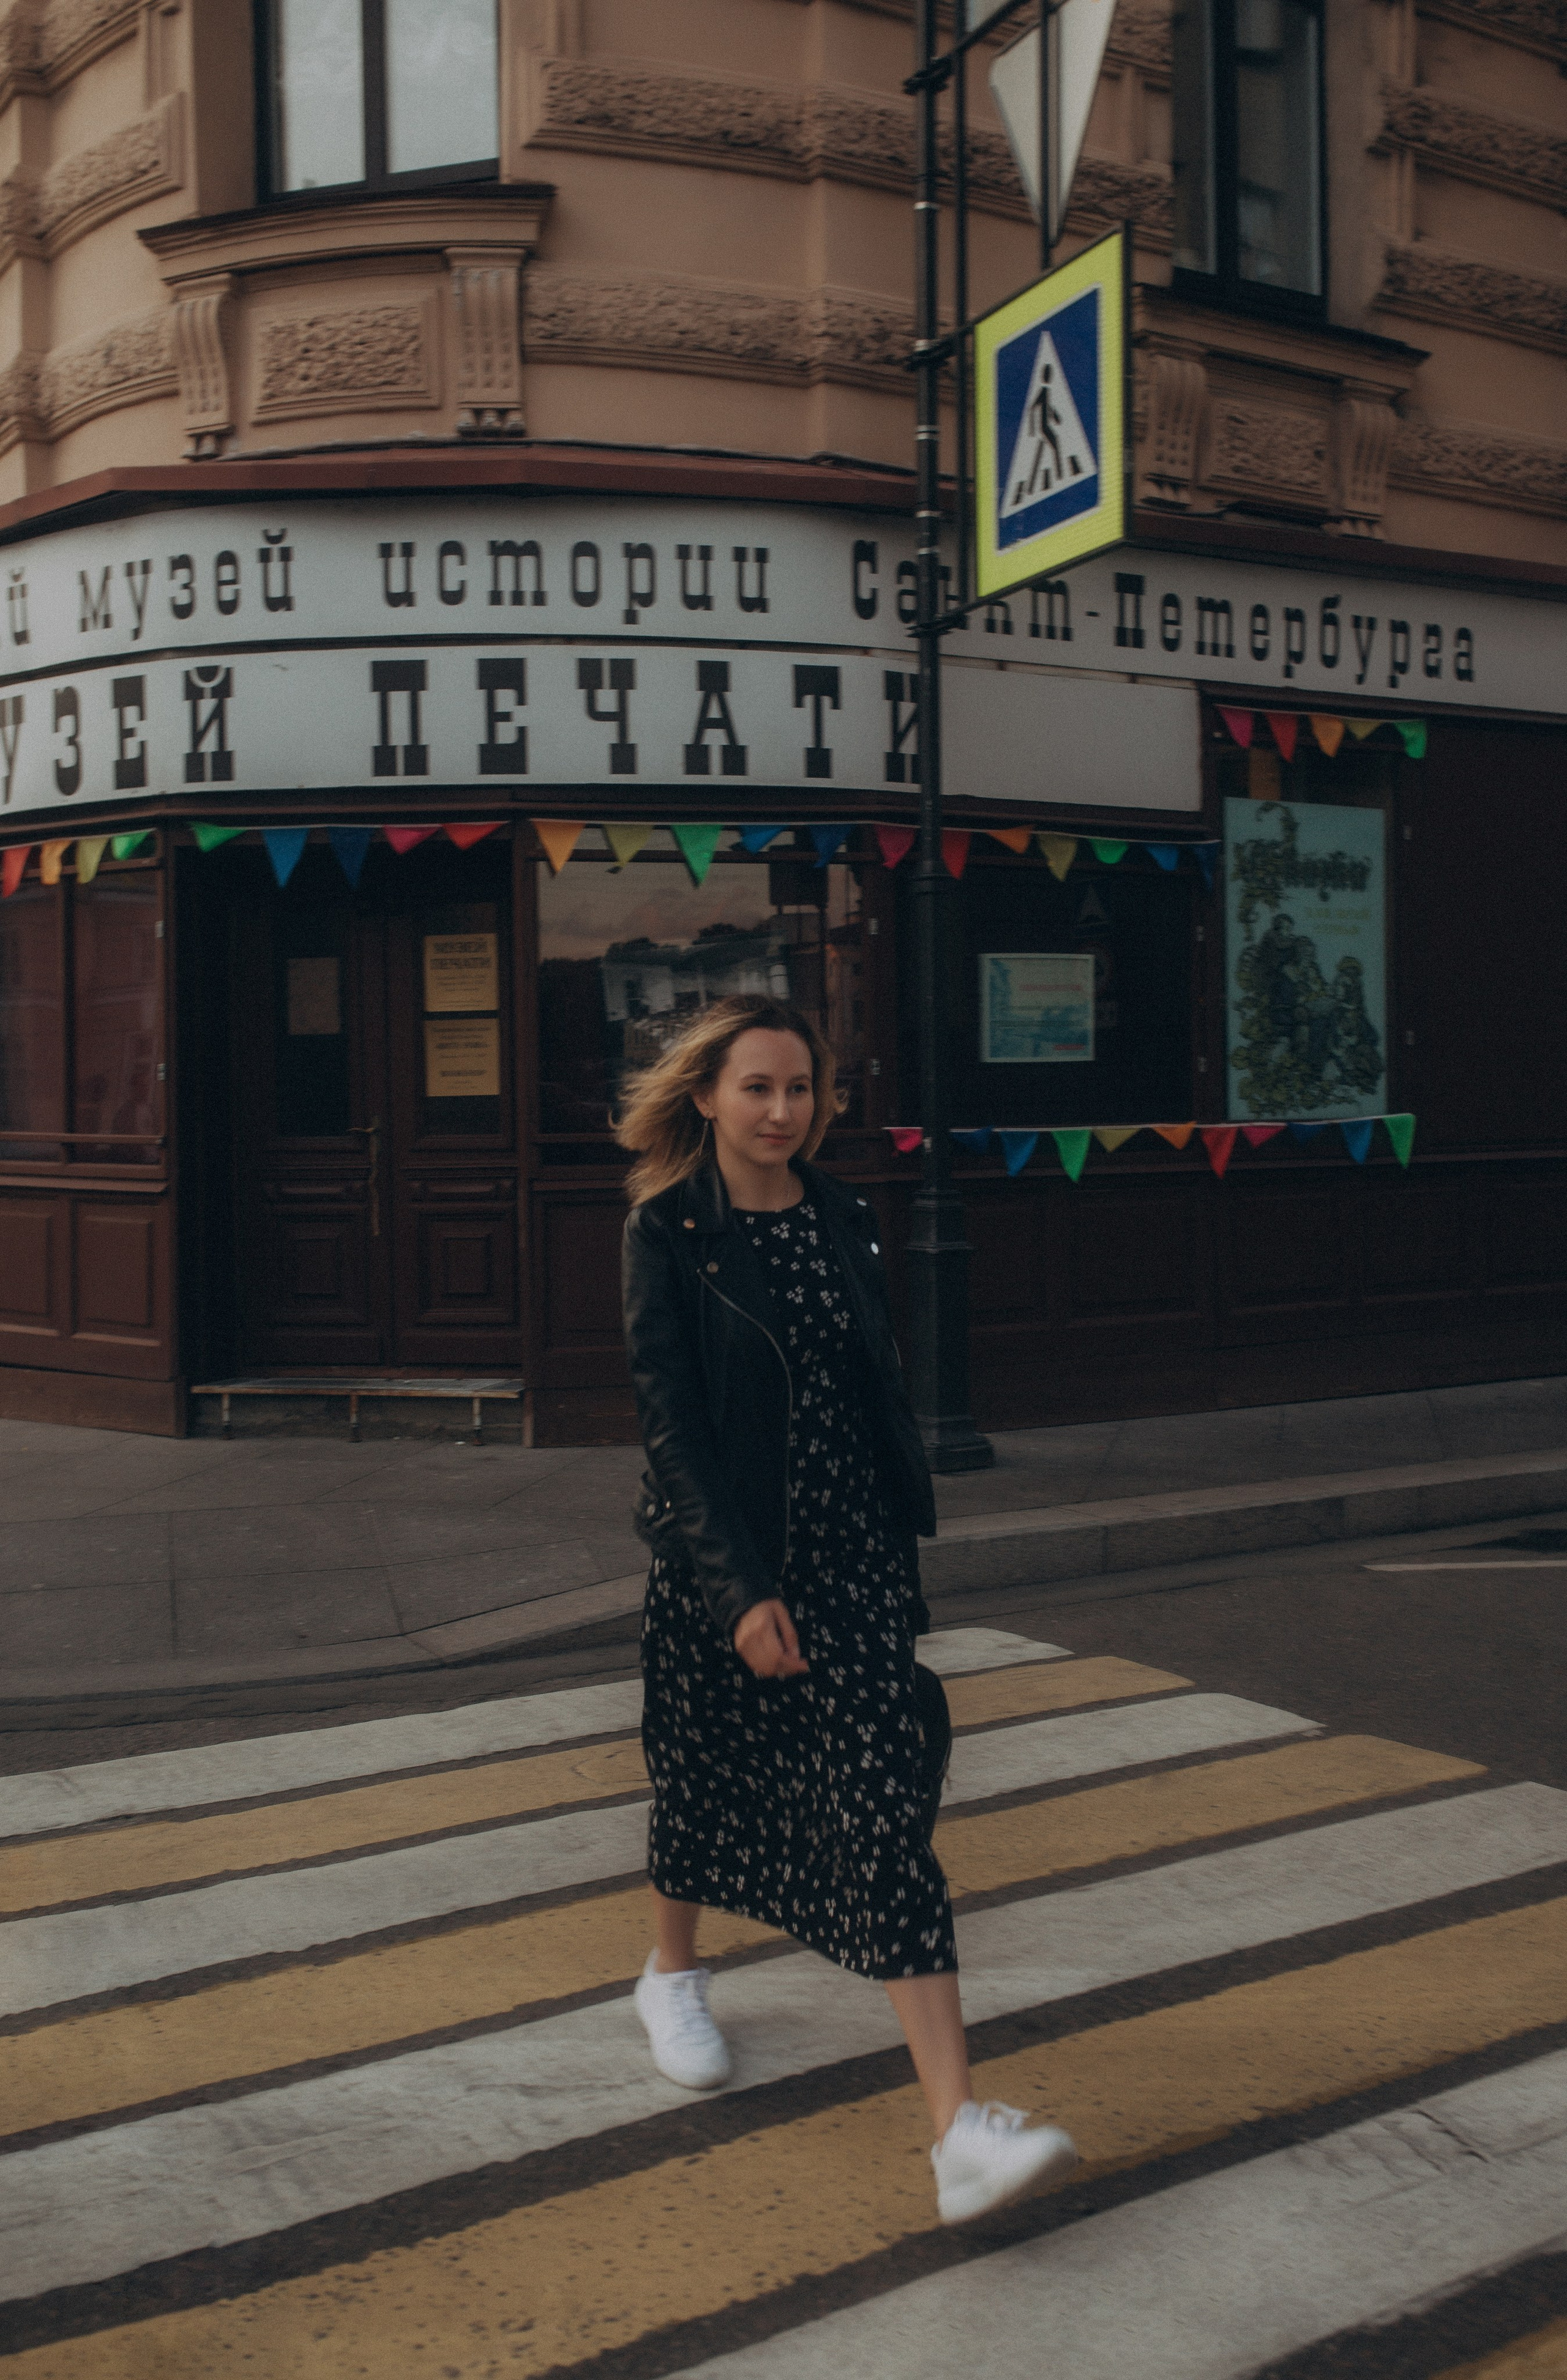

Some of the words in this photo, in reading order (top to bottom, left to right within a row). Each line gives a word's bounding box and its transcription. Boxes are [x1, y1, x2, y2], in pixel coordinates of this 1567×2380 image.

[78, 528, 294, 641] музей
[378, 539, 770, 625] истории
[371, 657, 920, 784] ПЕЧАТИ
